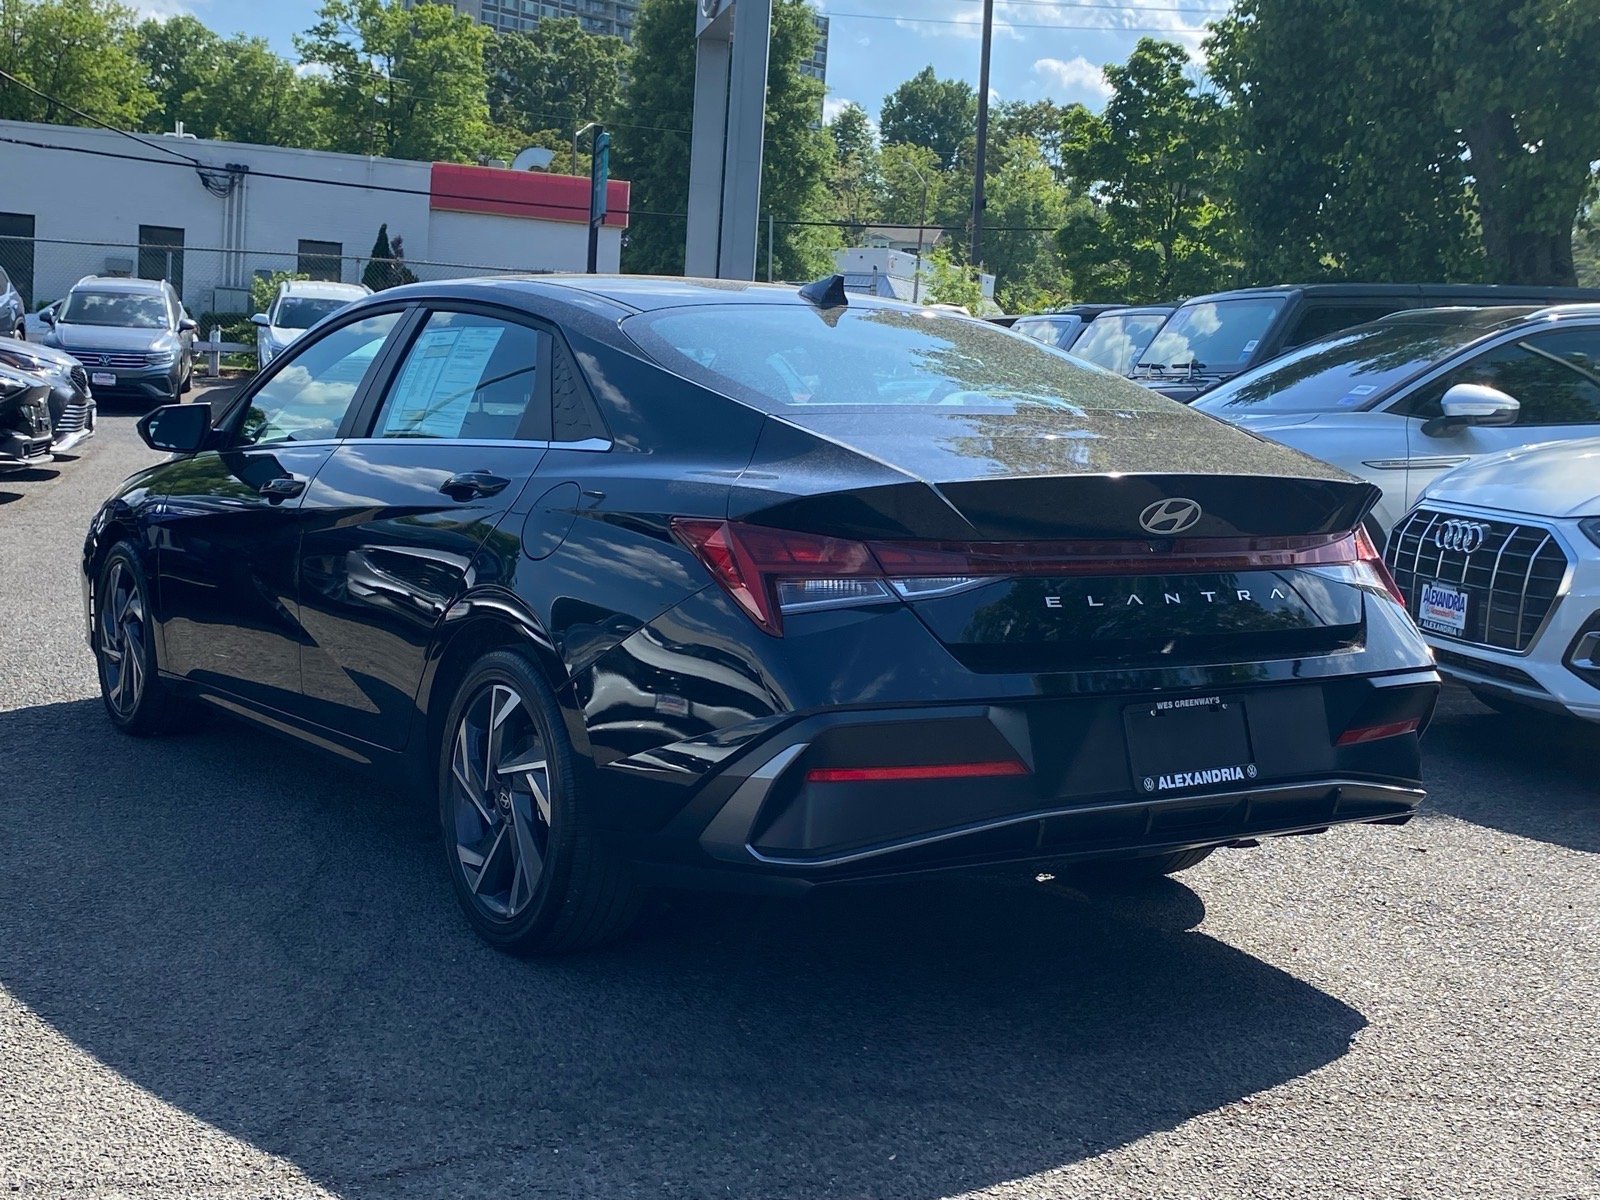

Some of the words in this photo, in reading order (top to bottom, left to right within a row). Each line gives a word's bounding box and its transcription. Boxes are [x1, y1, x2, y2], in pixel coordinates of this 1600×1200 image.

[1045, 588, 1284, 608] ELANTRA
[1423, 587, 1465, 613] ALEXANDRIA
[1422, 619, 1457, 636] ALEXANDRIA
[1156, 701, 1173, 710] WES
[1174, 696, 1220, 708] GREENWAY'S
[1158, 766, 1245, 790] ALEXANDRIA
